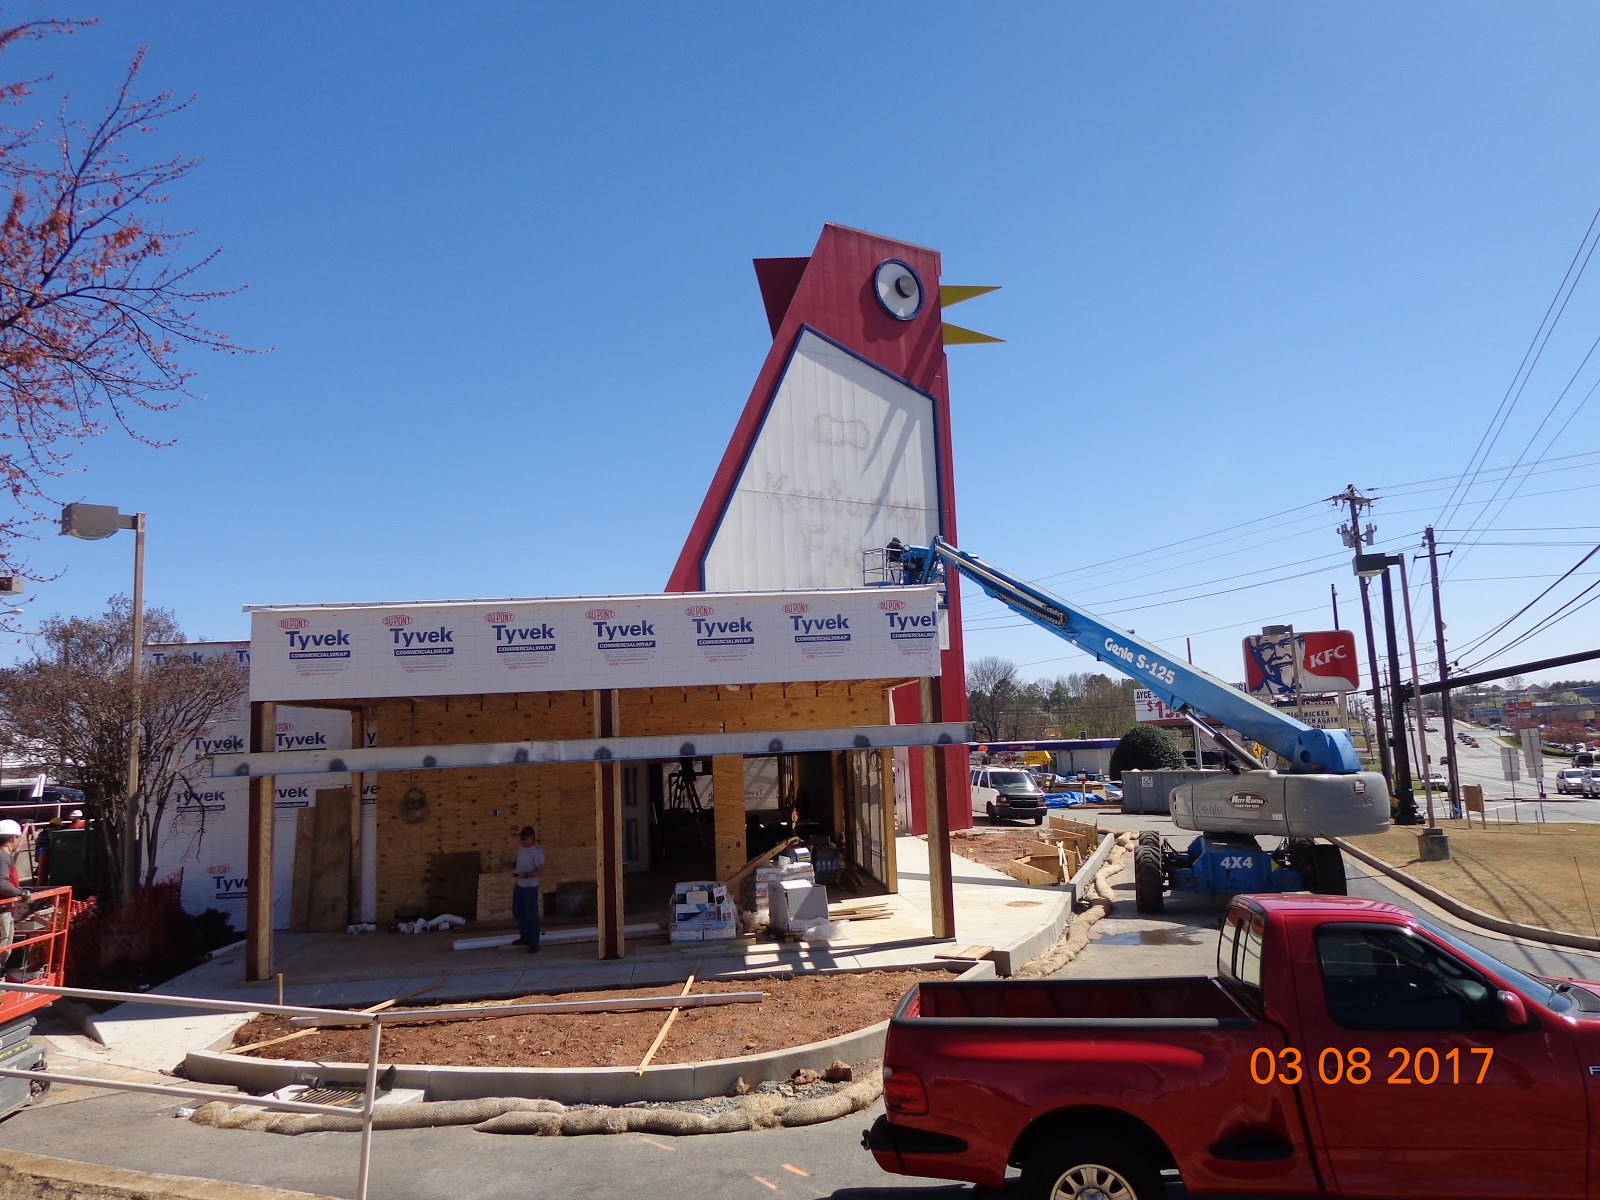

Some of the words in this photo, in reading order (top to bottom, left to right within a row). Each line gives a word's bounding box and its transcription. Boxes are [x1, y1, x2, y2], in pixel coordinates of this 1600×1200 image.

[492, 624, 555, 644] Tyvek
[593, 620, 655, 640] Tyvek
[692, 617, 753, 637] Tyvek
[790, 614, 850, 634] Tyvek
[285, 630, 351, 650] Tyvek
[390, 627, 454, 647] Tyvek
[1104, 638, 1134, 663] Genie
[1136, 654, 1176, 684] S-125
[1309, 645, 1346, 668] KFC
[1136, 691, 1152, 699] AYCE
[194, 736, 244, 752] Tyvek
[276, 732, 326, 748] Tyvek
[1220, 856, 1252, 868] 4X4
[212, 876, 248, 892] Tyv
